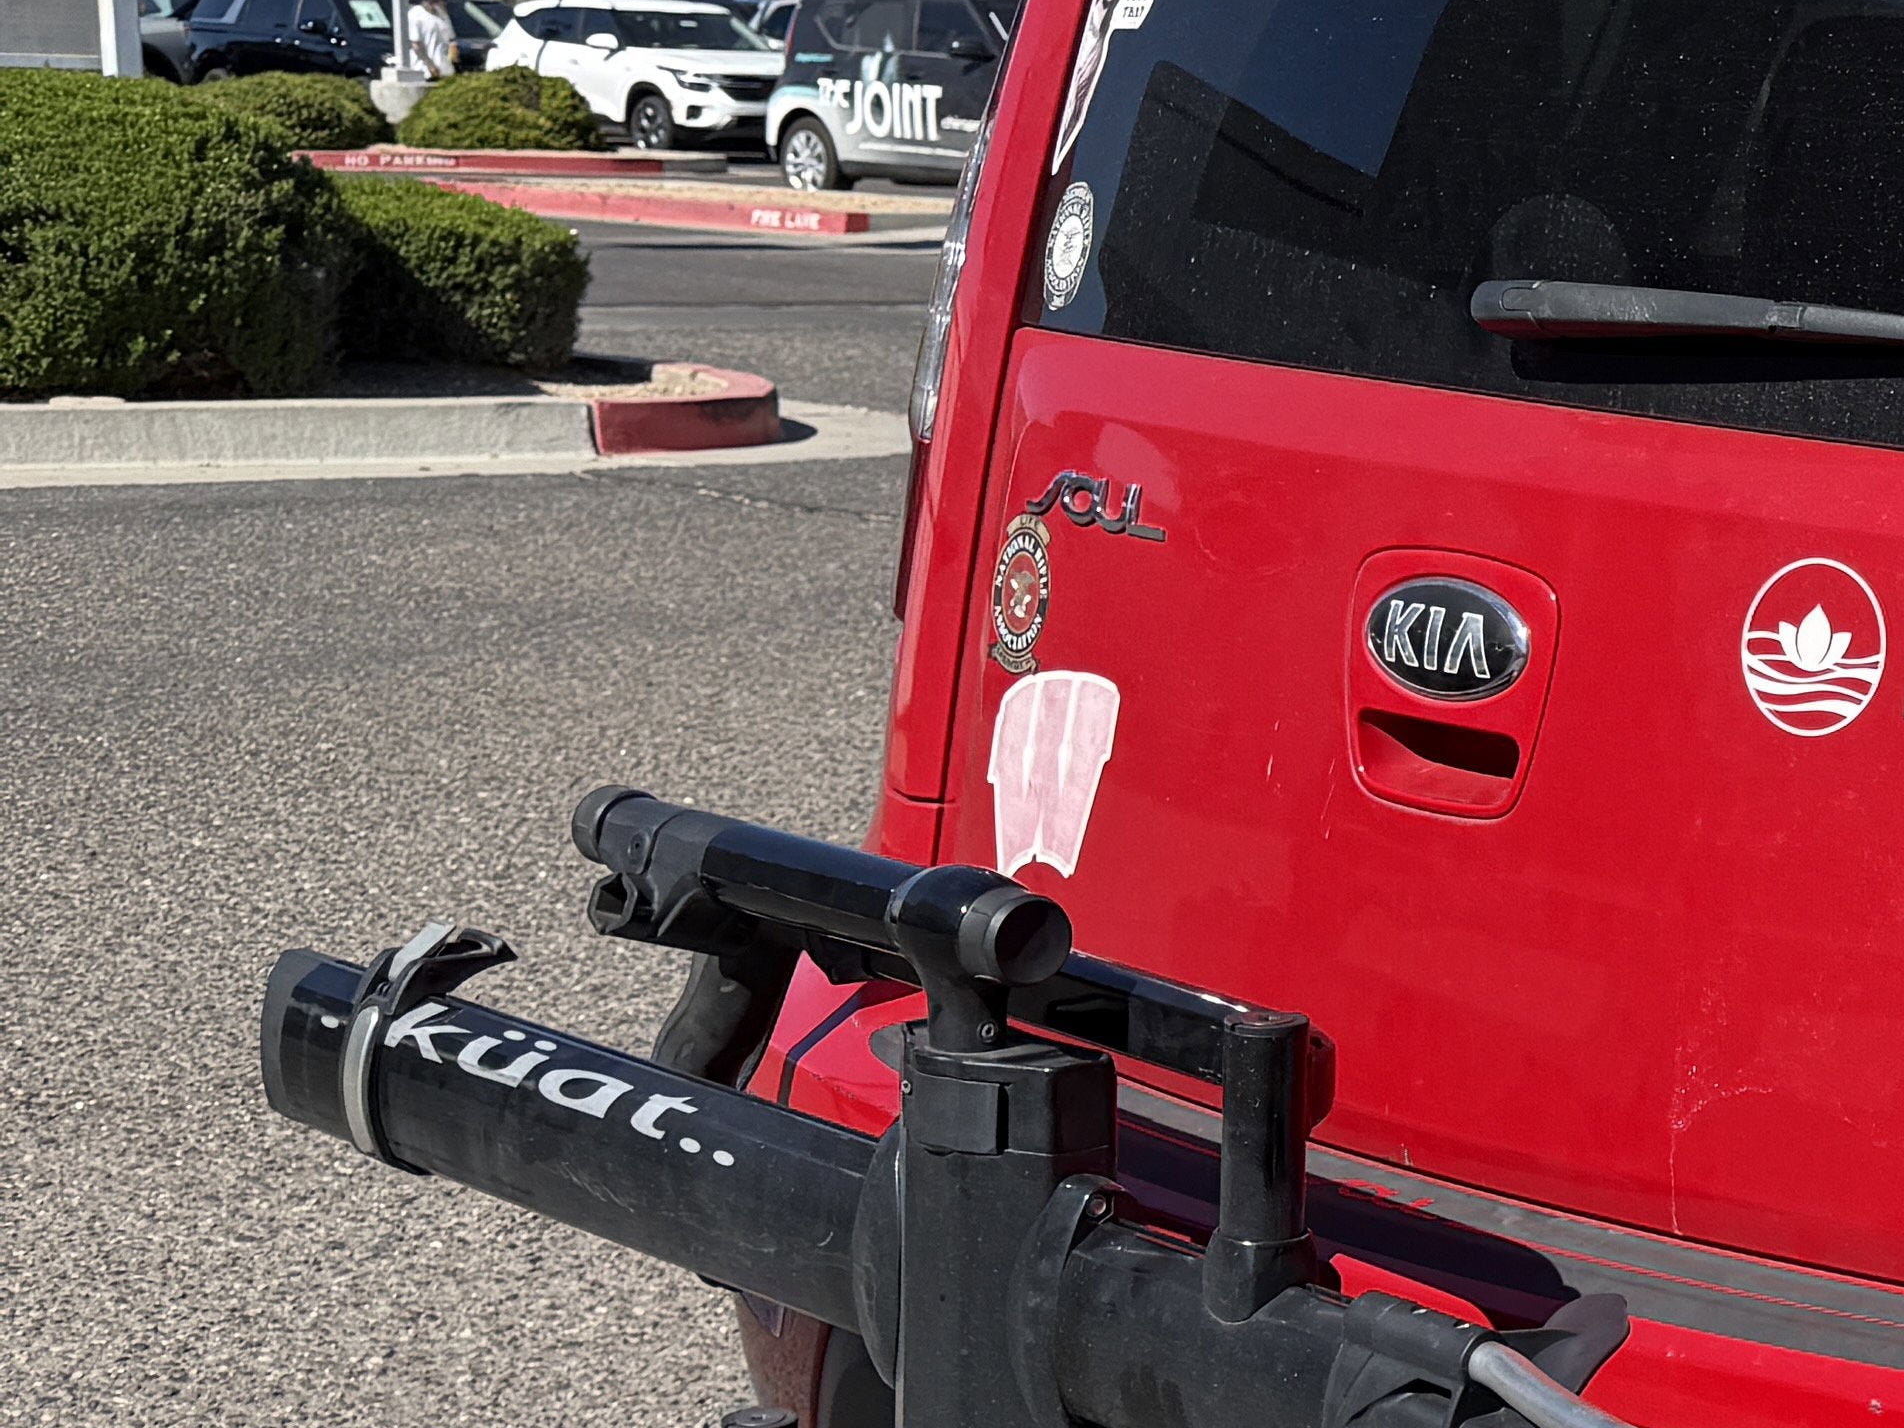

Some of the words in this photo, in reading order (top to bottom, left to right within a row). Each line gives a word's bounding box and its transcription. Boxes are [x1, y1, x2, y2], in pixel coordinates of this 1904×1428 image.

[845, 80, 943, 142] JOINT
[344, 155, 369, 166] NO
[1383, 599, 1491, 679] KIA
